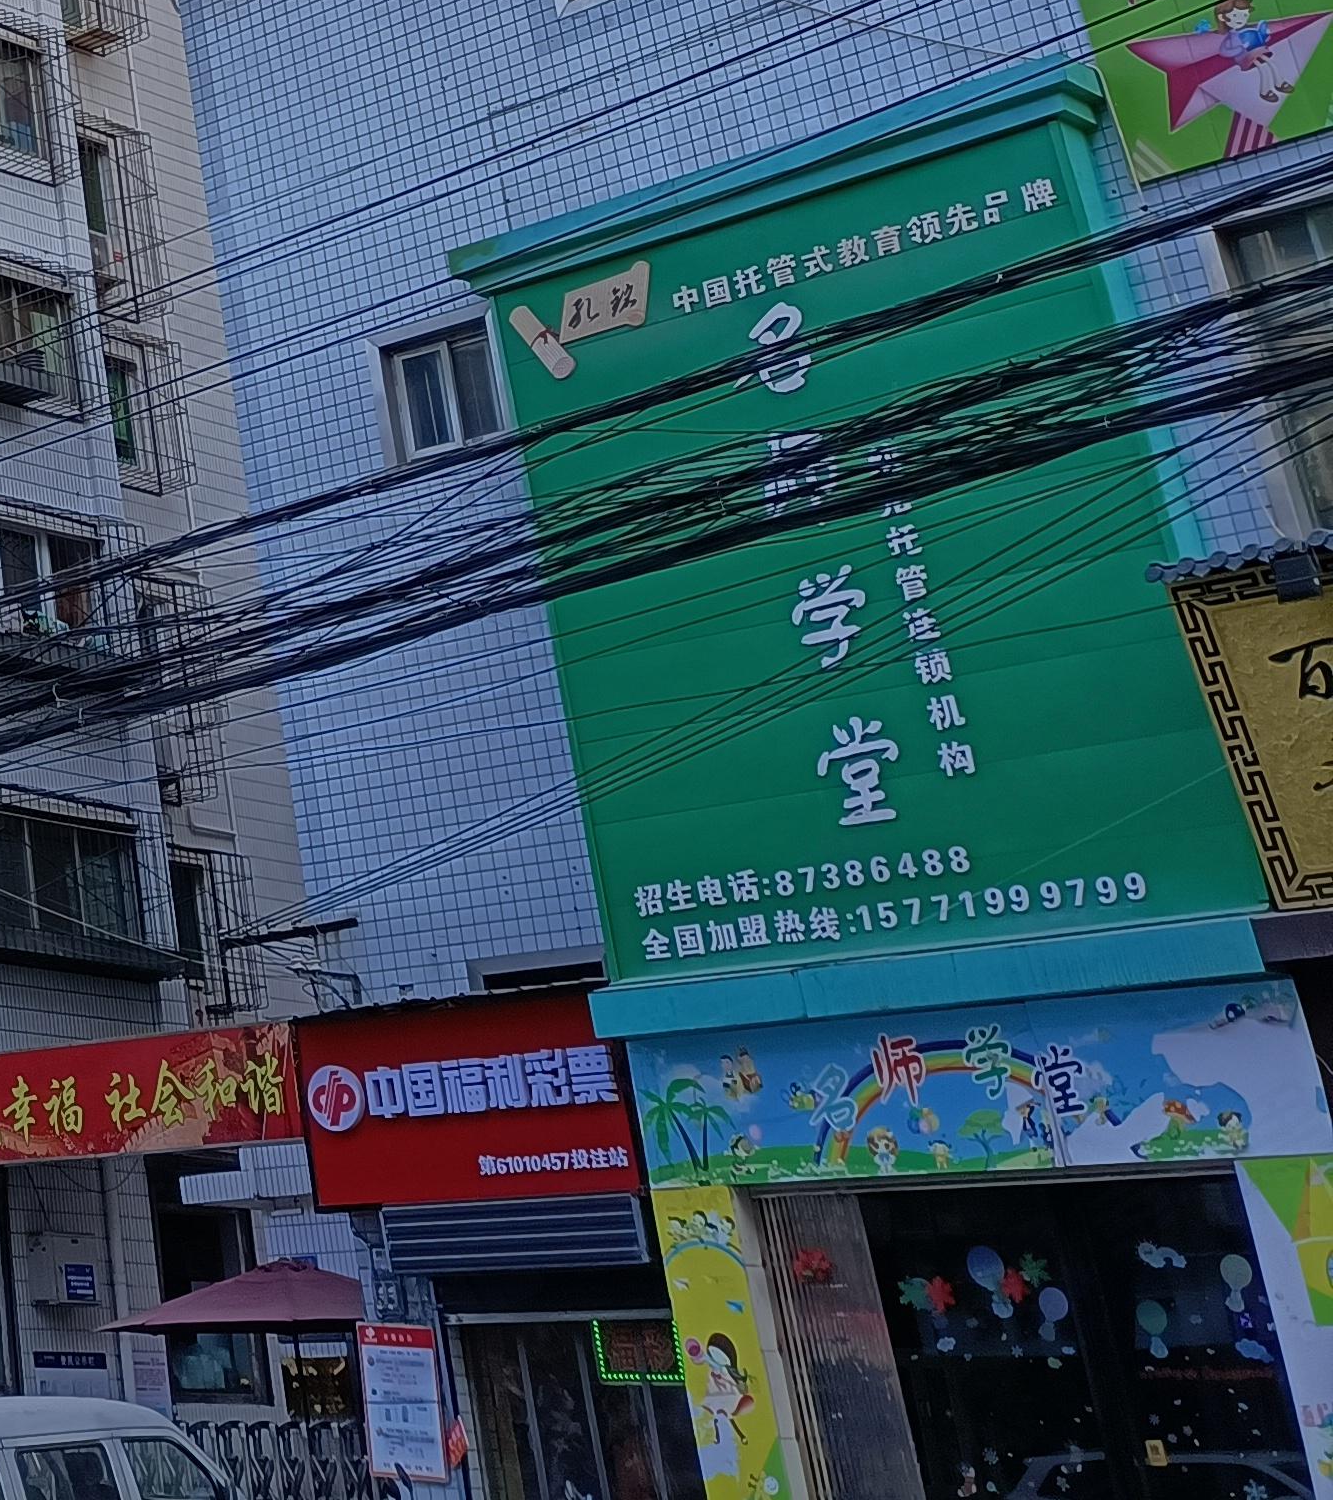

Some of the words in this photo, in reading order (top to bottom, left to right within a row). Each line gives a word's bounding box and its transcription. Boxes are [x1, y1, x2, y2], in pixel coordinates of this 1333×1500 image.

[672, 177, 1058, 314] 中国托管式教育领先品牌
[867, 444, 976, 778] 托管连锁机构
[633, 845, 971, 918] 招生电话:87386488
[641, 871, 1148, 961] 全国加盟热线:15771999799
[104, 1051, 285, 1133] 社会和谐
[363, 1044, 620, 1119] 中国福利彩票
[478, 1146, 629, 1177] 第61010457投注站
